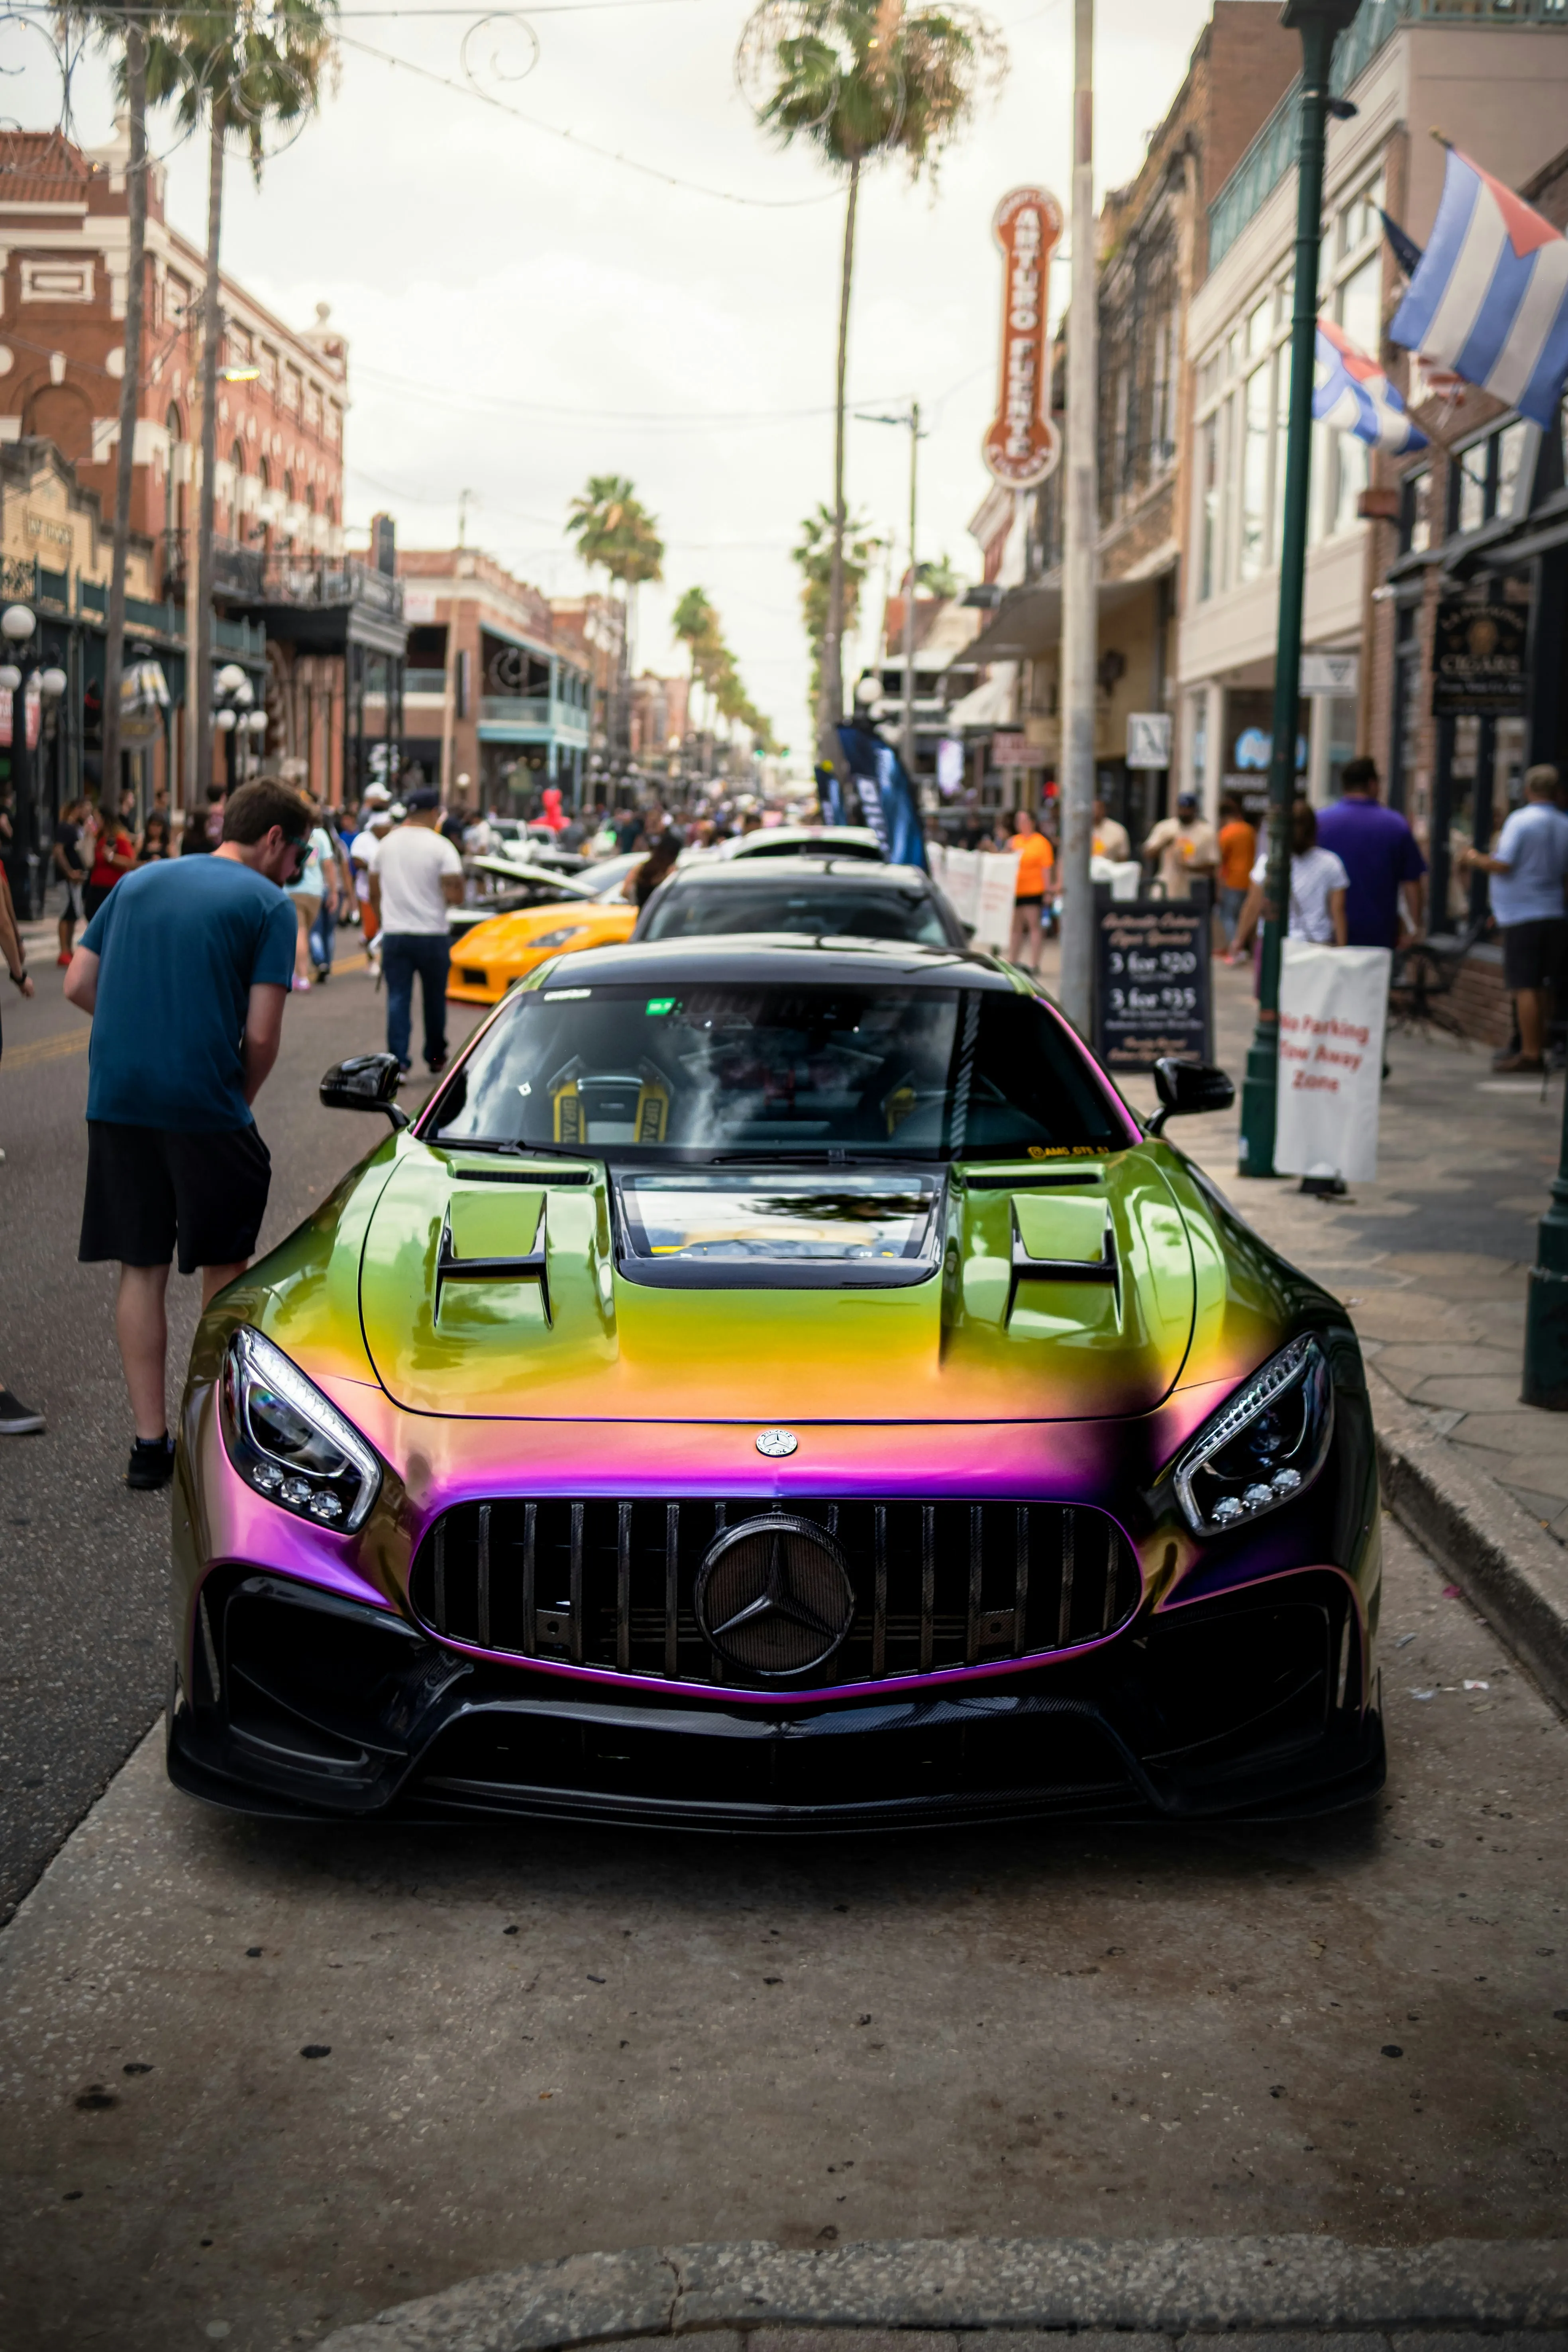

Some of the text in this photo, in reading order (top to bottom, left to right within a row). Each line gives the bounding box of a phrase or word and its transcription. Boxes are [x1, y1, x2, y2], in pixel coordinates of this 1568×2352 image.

[1109, 952, 1124, 974] 3
[1127, 951, 1158, 974] for
[1109, 988, 1124, 1011] 3
[1128, 987, 1159, 1009] for
[1303, 1015, 1369, 1046] Parking
[1280, 1039, 1363, 1073] Tow Away
[1292, 1070, 1339, 1093] Zone
